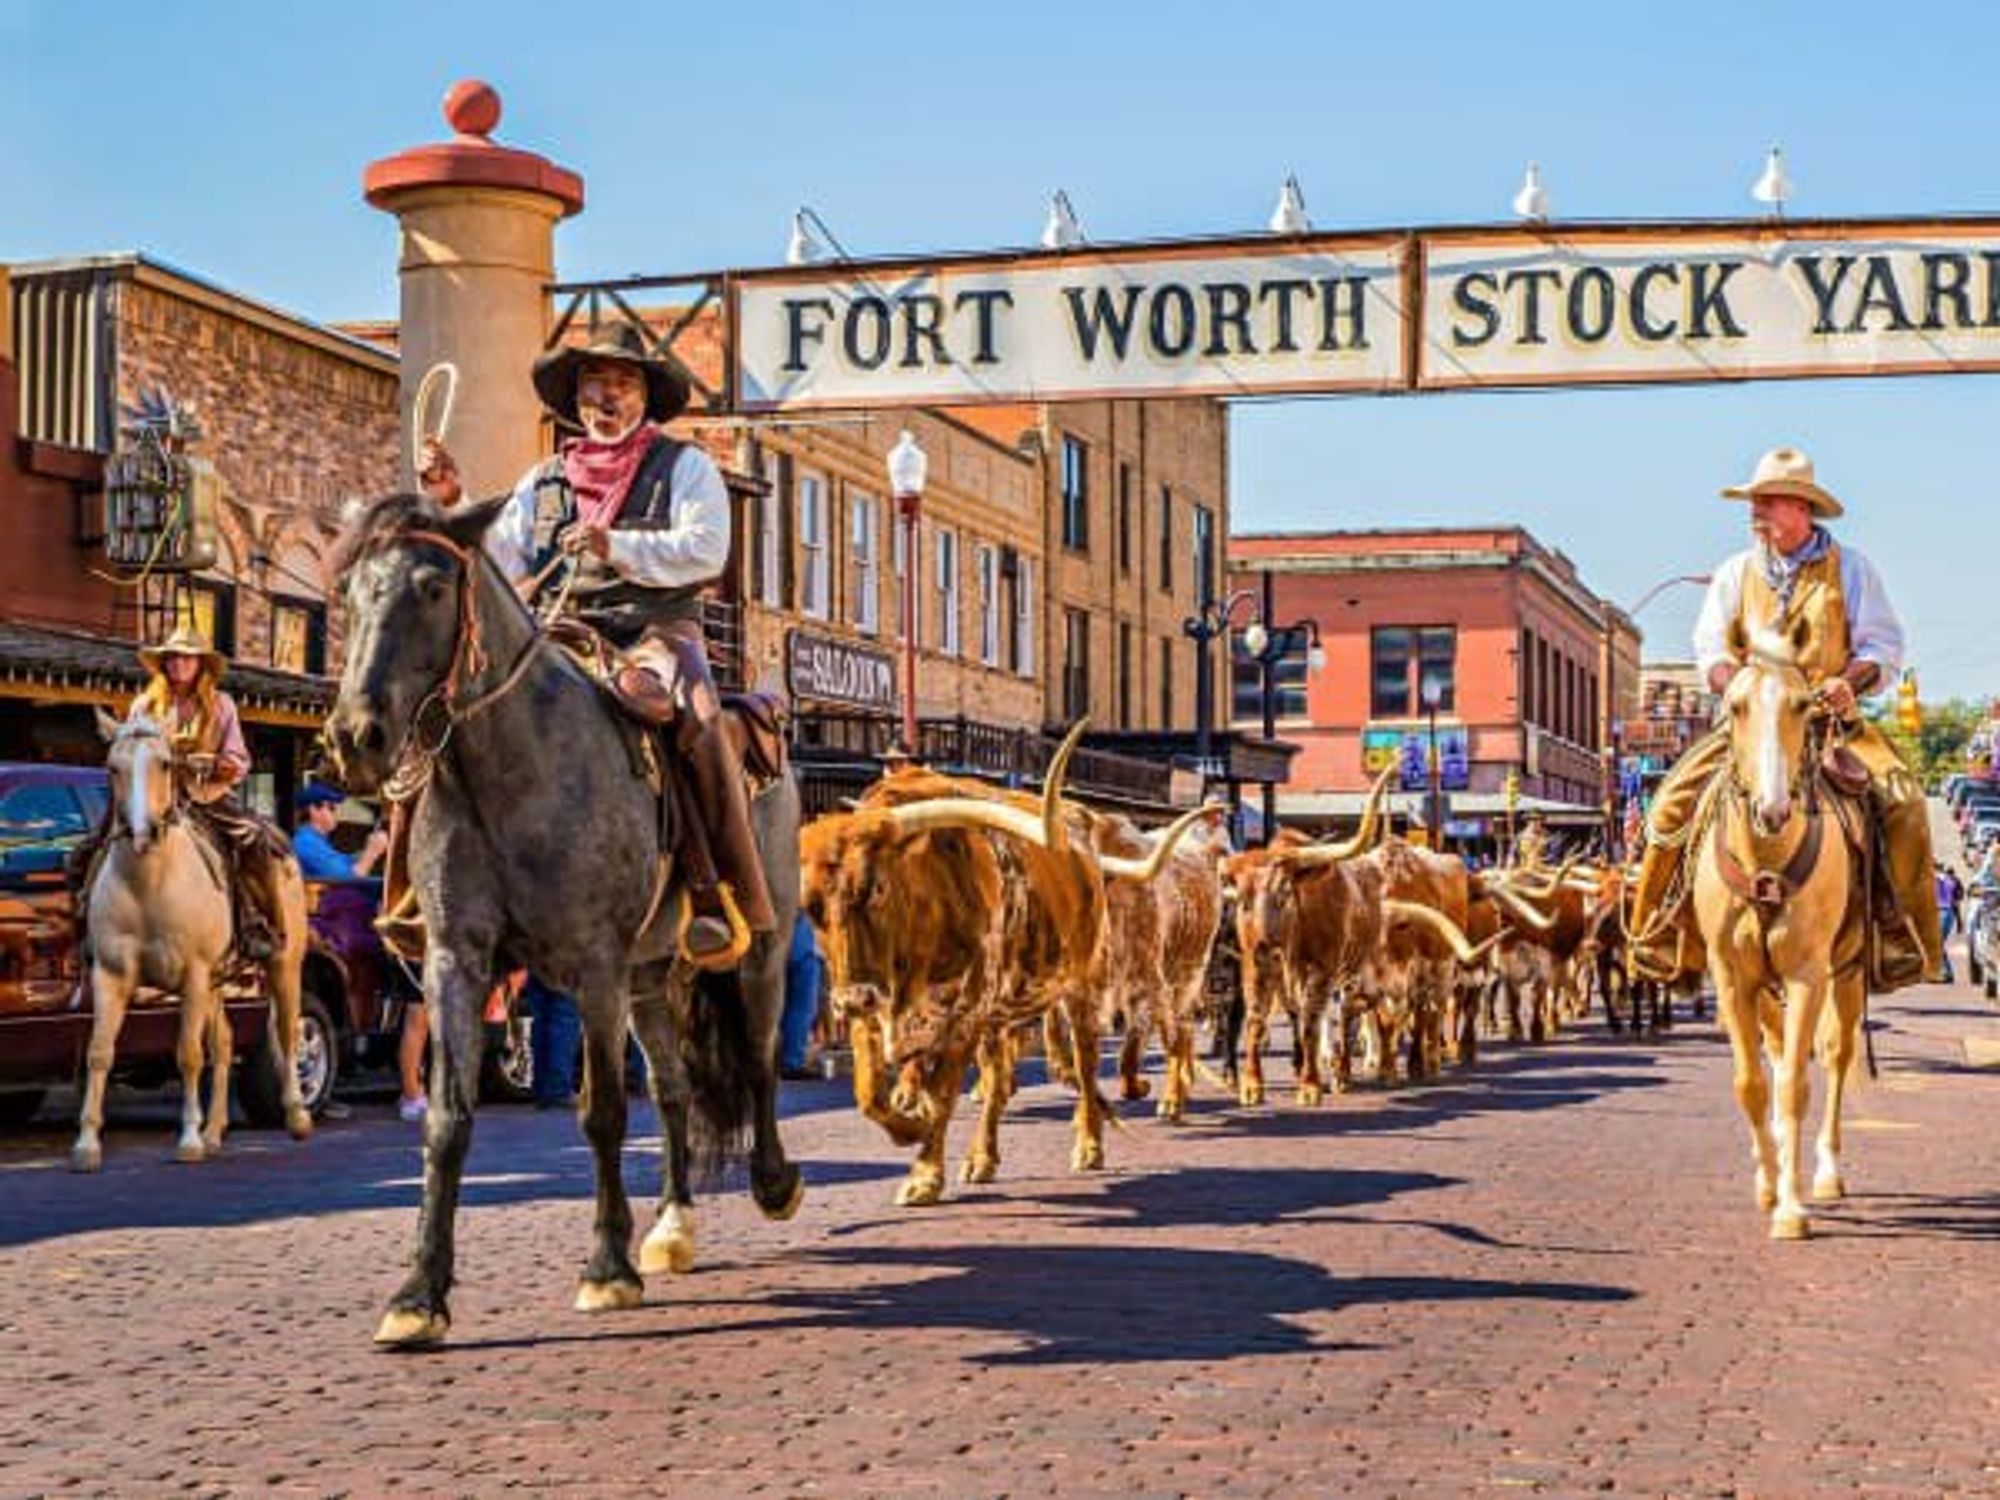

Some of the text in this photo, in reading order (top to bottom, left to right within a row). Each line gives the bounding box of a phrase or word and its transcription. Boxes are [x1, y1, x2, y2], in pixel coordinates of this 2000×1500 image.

[782, 290, 1014, 371] FORT
[1063, 276, 1371, 360] WORTH
[1452, 262, 1746, 346] STOCK
